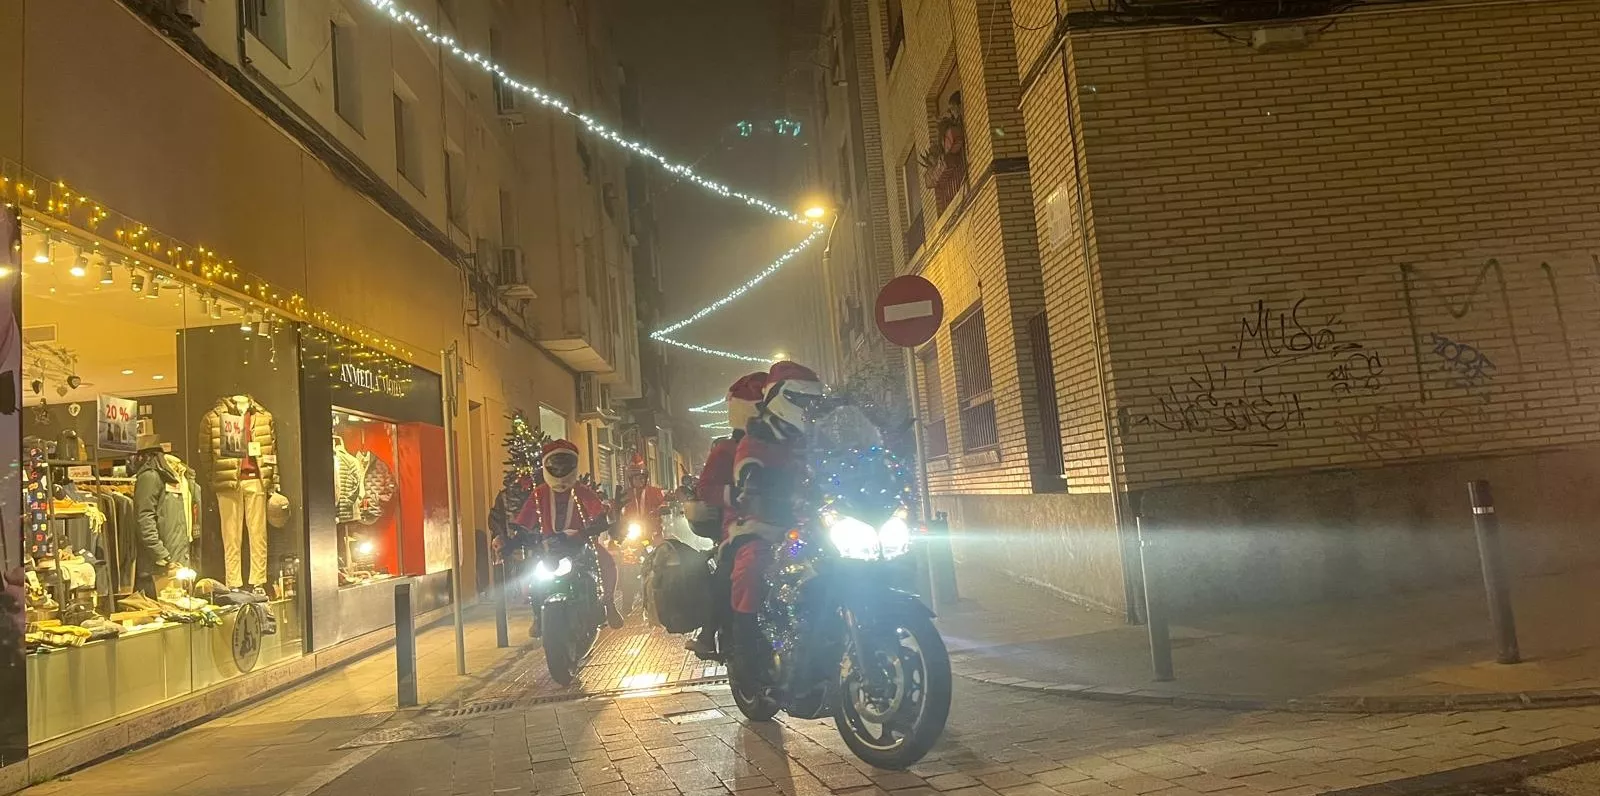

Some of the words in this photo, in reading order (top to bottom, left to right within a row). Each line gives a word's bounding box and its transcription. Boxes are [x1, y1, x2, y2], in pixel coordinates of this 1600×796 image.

[106, 404, 117, 420] 20
[119, 406, 130, 422] %
[225, 420, 232, 433] 20
